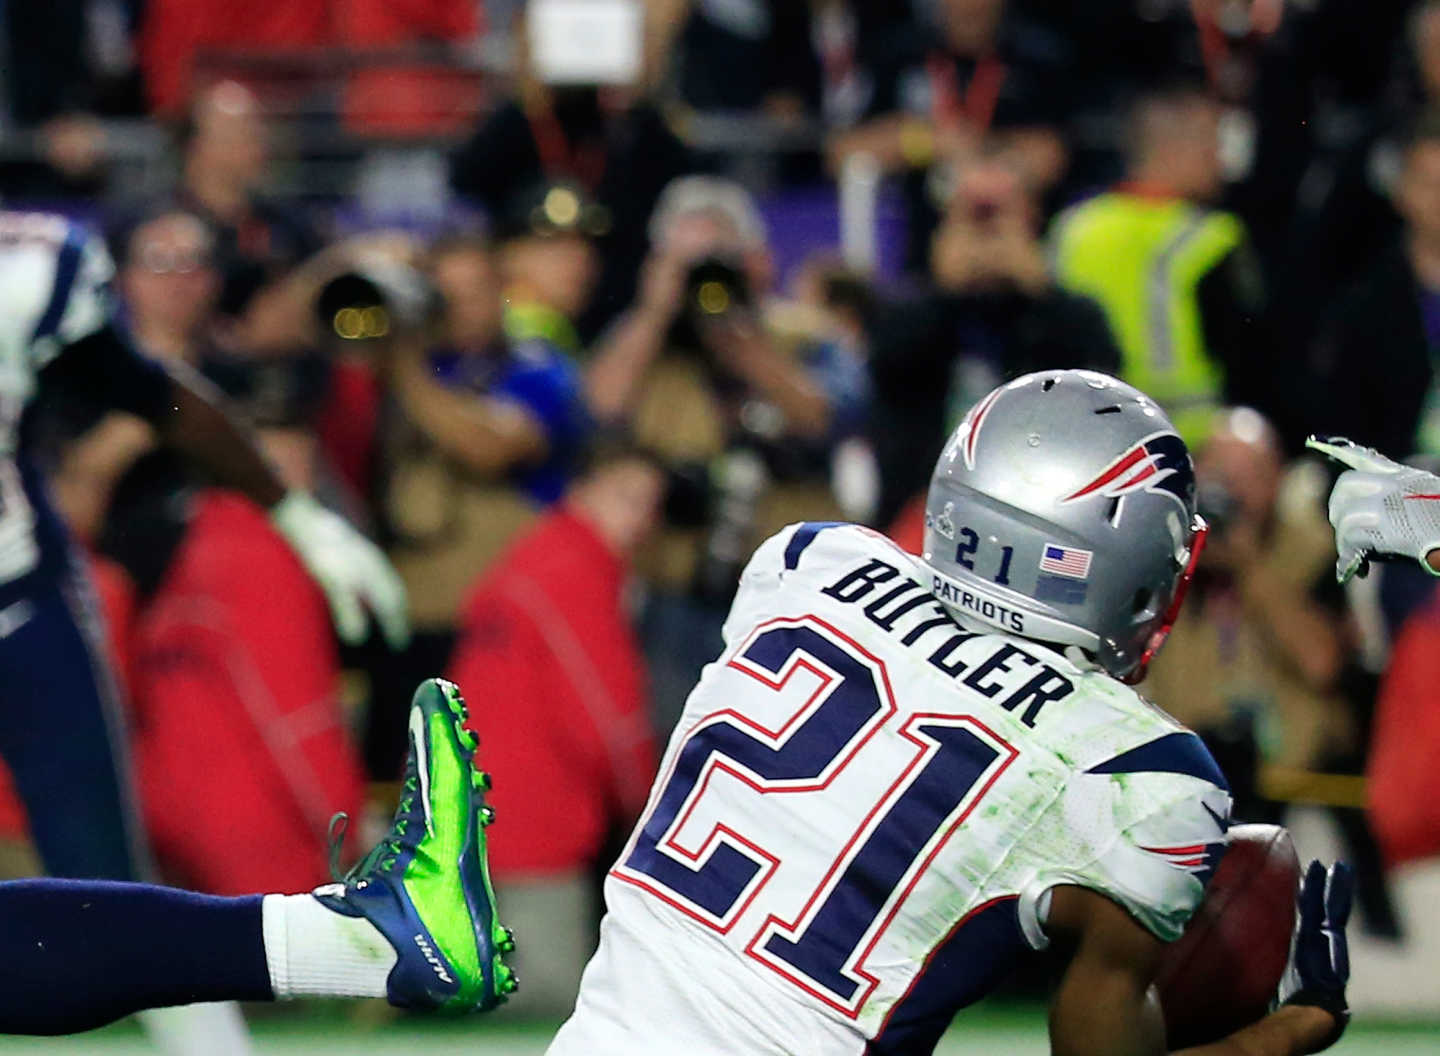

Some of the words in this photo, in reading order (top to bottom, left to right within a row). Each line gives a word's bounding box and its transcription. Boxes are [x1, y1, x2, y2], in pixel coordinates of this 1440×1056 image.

[932, 575, 1024, 633] PATRIOTS
[955, 526, 1014, 585] 21
[820, 558, 1075, 729] BUTLER
[608, 614, 1020, 1020] 21
